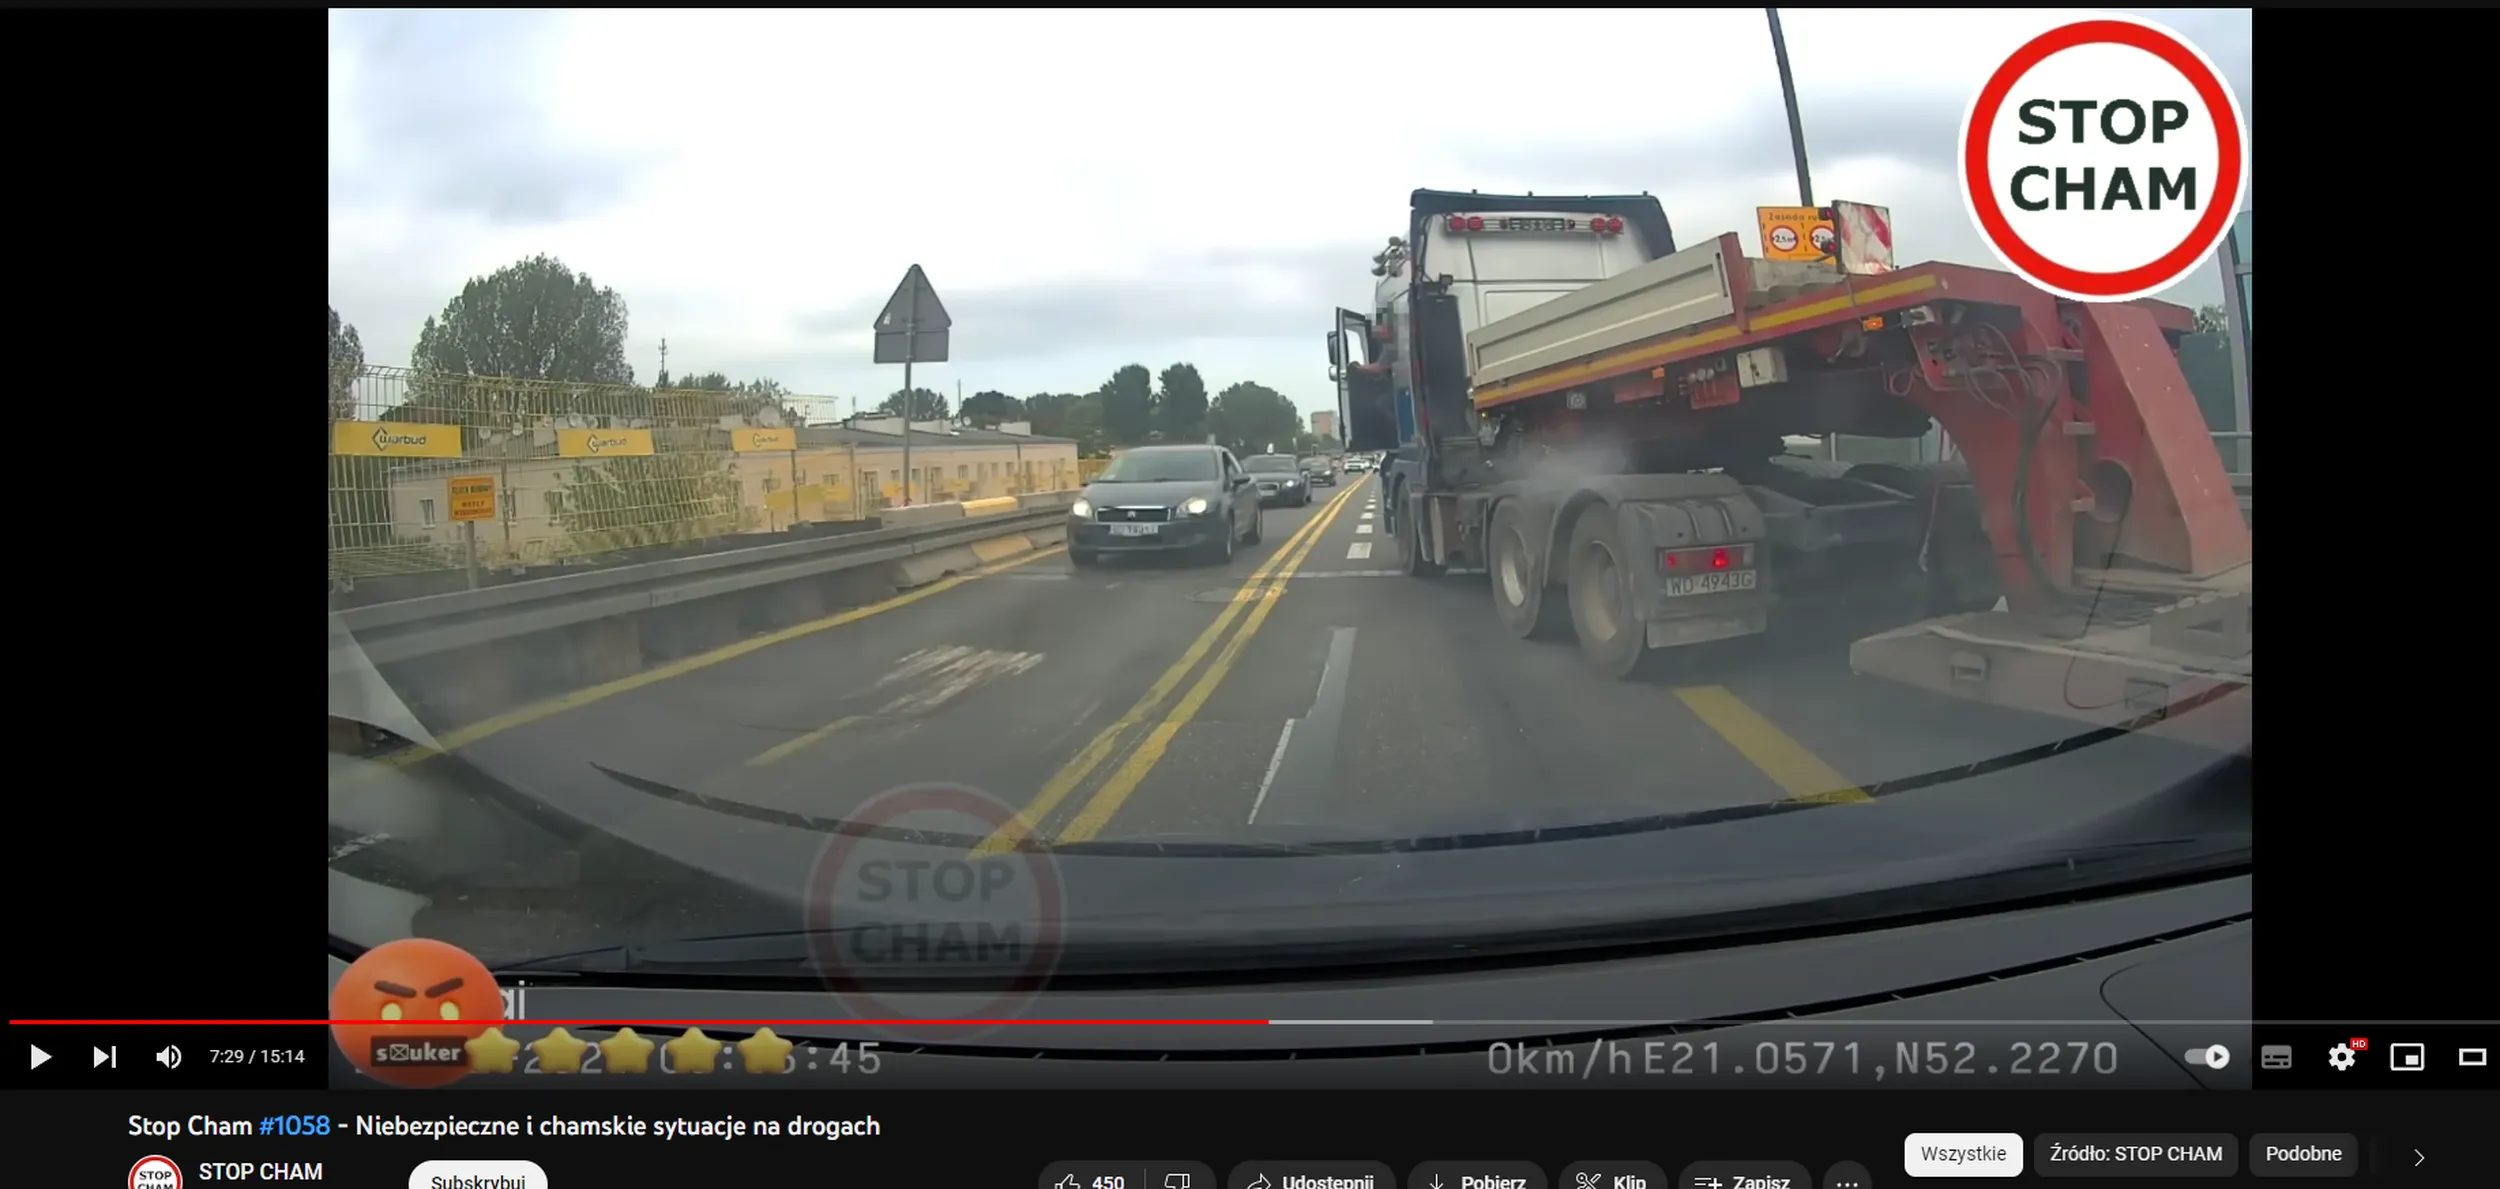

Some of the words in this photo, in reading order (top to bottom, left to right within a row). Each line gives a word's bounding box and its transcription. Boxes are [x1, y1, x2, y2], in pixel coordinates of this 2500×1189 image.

[1671, 576, 1695, 594] WD
[1701, 571, 1753, 592] 4943G
[2352, 1040, 2366, 1048] HD
[209, 1049, 244, 1064] 7:29
[260, 1049, 306, 1064] 15:14
[128, 1114, 181, 1141] Stop
[187, 1114, 253, 1136] Cham
[259, 1114, 331, 1136] #1058
[356, 1114, 519, 1141] Niebezpieczne
[526, 1114, 533, 1136] i
[539, 1114, 646, 1136] chamskie
[653, 1114, 746, 1141] sytuacje
[753, 1120, 781, 1136] na
[787, 1114, 880, 1141] drogach
[1921, 1145, 2006, 1165] Wszystkie
[2050, 1141, 2111, 1162] Źródło:
[2114, 1146, 2163, 1162] STOP
[2167, 1146, 2223, 1162] CHAM
[2266, 1145, 2343, 1162] Podobne
[140, 1171, 172, 1180] STOP
[198, 1162, 255, 1181] STOP
[260, 1162, 323, 1181] CHAM
[1092, 1176, 1125, 1189] 450
[1462, 1175, 1527, 1189] Pobierz
[1733, 1175, 1791, 1189] Zapisz
